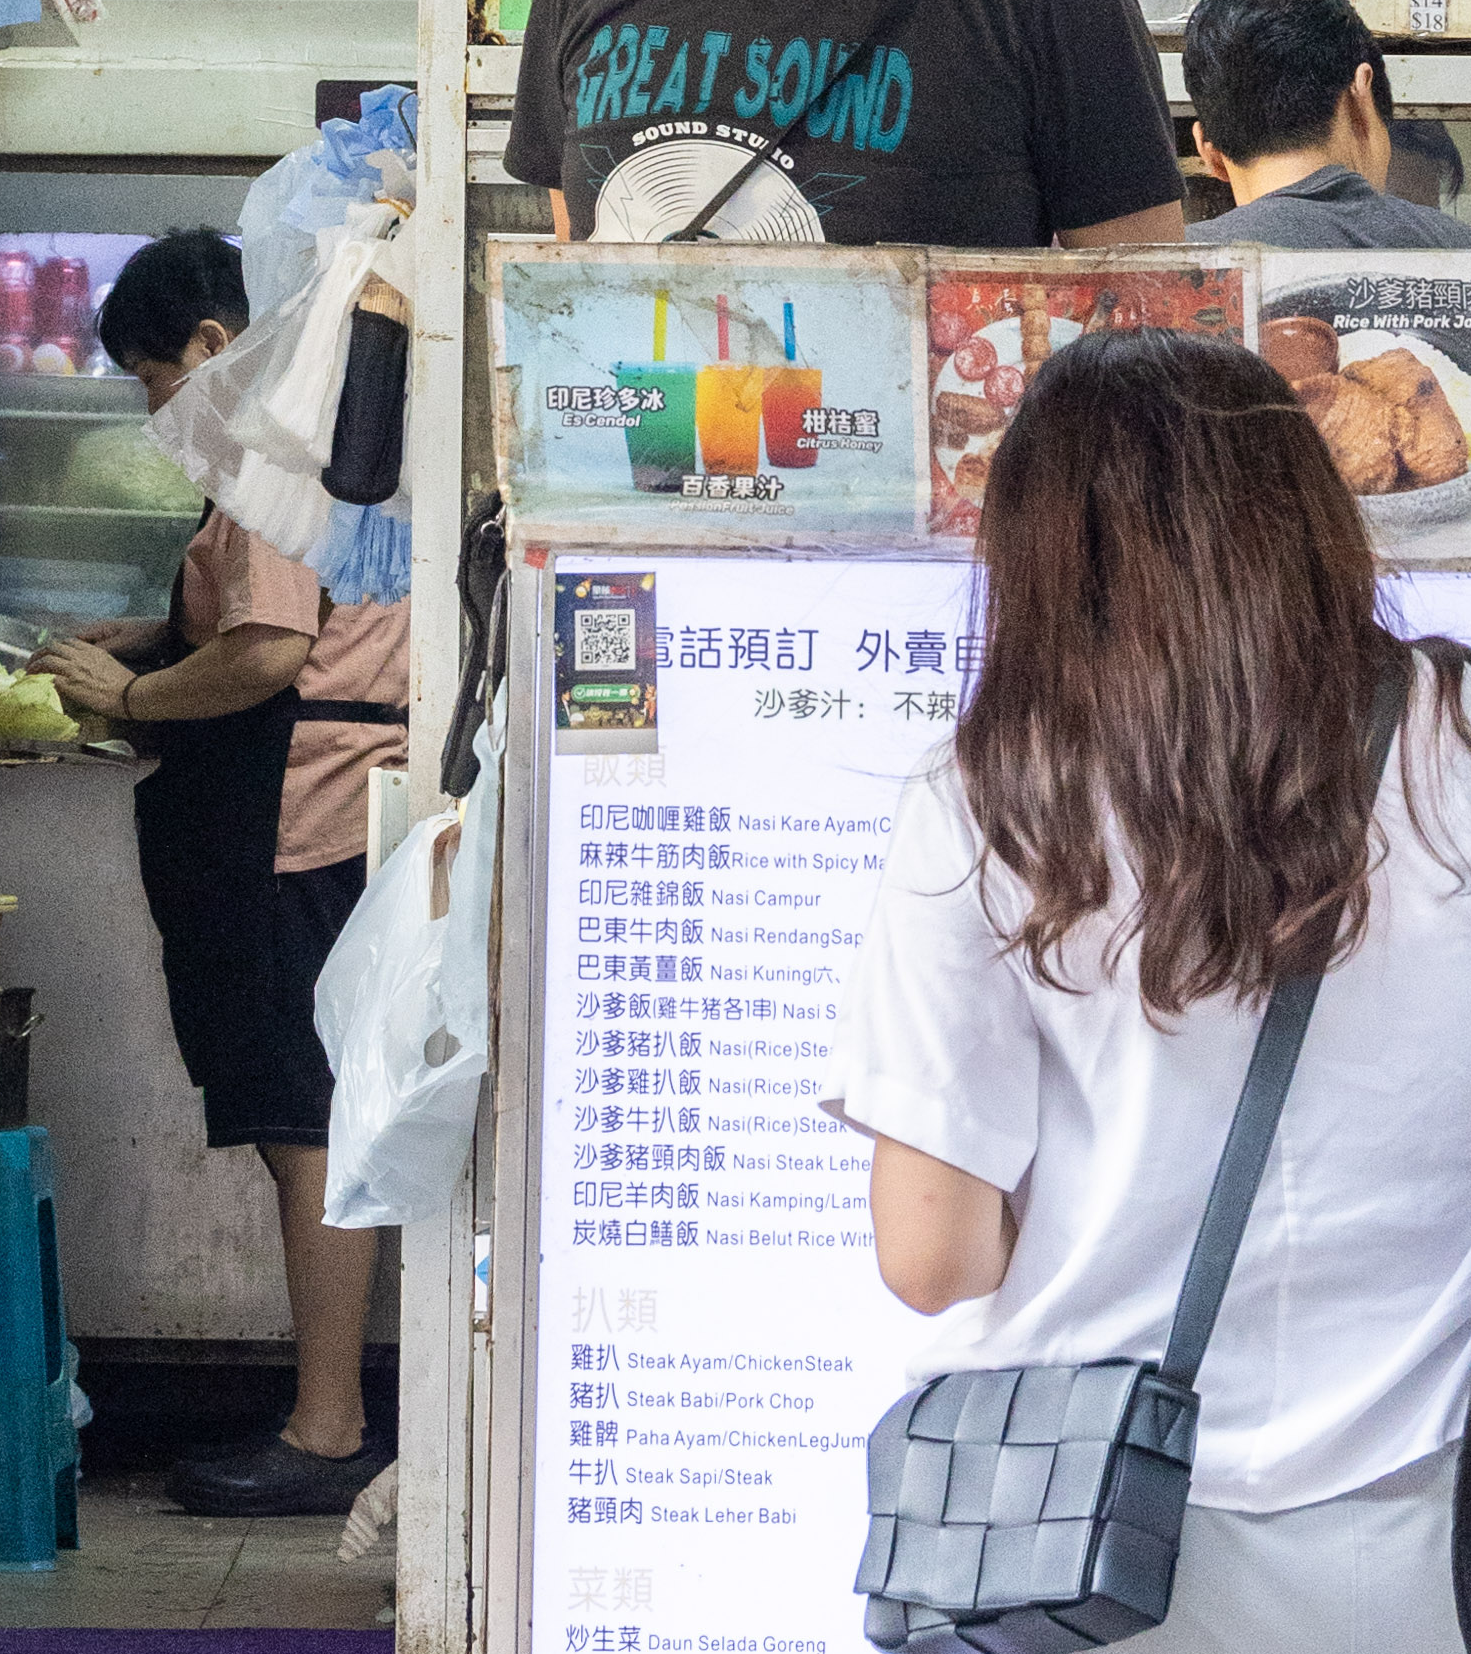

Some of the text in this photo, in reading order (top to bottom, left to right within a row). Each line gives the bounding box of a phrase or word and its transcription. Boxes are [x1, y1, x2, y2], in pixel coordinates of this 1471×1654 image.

[576, 23, 913, 154] GREAT SOUND
[632, 122, 707, 146] SOUND
[1333, 313, 1372, 330] Rice
[1373, 313, 1409, 329] With
[1412, 314, 1451, 329] Pork
[546, 386, 665, 412] 印尼珍多冰
[562, 413, 641, 428] Es Cendol
[802, 408, 880, 437] 柑桔蜜
[796, 437, 883, 453] Citrus Honey
[681, 474, 784, 500] 百香果汁
[579, 879, 821, 910] 印尼雜錦飯 Nasi Campur
[571, 1343, 619, 1372] 雞扒
[627, 1352, 677, 1370] Steak
[565, 1624, 641, 1653] 炒生菜
[648, 1634, 693, 1652] Daun
[698, 1634, 758, 1653] Selada
